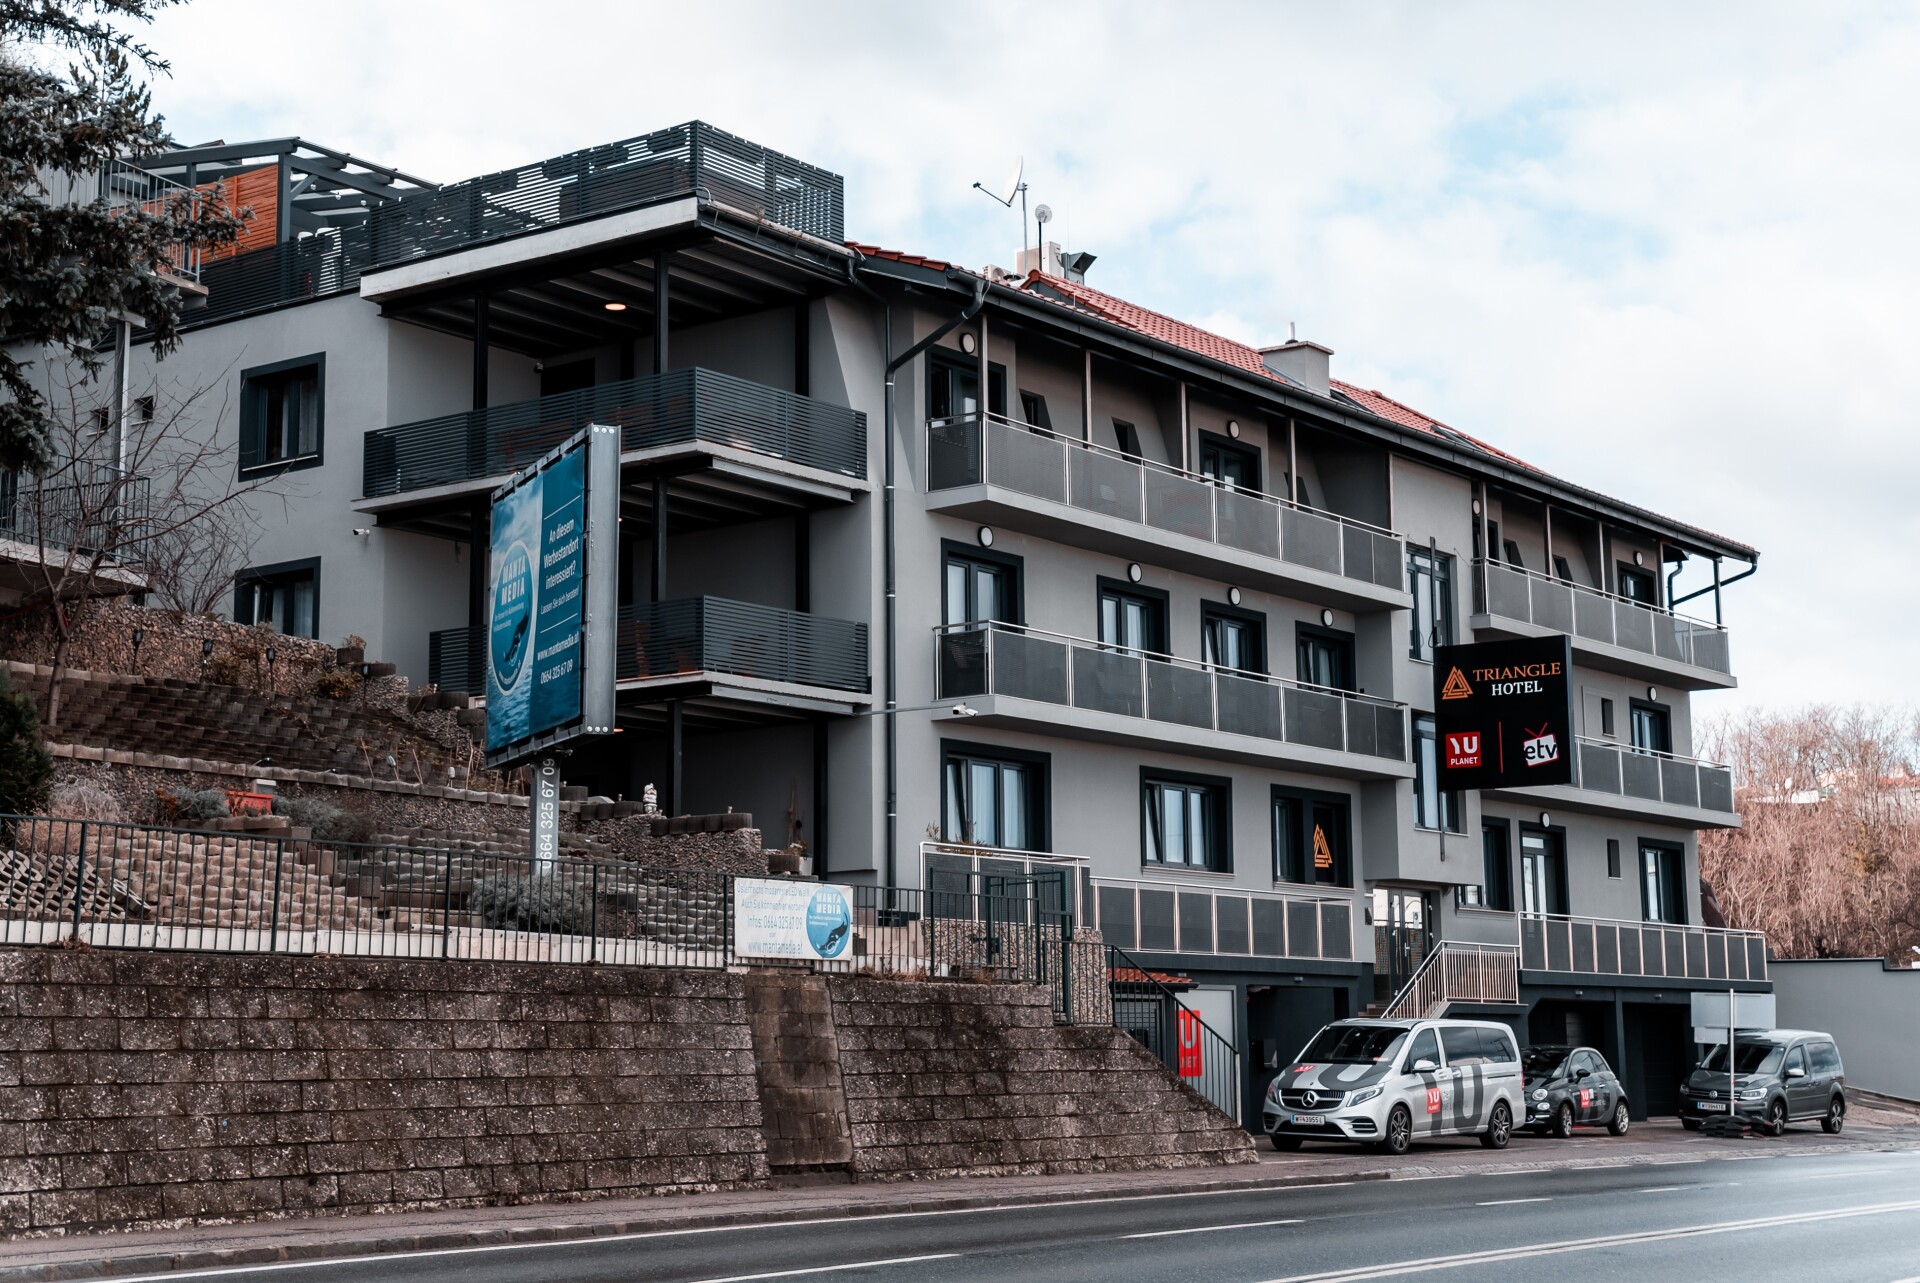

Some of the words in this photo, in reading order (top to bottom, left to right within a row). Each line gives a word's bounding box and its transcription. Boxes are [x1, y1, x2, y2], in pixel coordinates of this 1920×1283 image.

[549, 529, 556, 544] An
[556, 518, 575, 539] diesem
[543, 536, 579, 569] Werbestandort
[502, 555, 526, 585] MANTA
[545, 560, 576, 590] interessiert?
[501, 577, 525, 606] MEDIA
[540, 600, 553, 615] Lassen
[537, 630, 580, 661] www.mantamedia.at
[552, 664, 561, 680] 325
[560, 661, 567, 676] 67
[566, 658, 574, 673] 09
[1472, 662, 1561, 682] TRIANGLE
[1491, 680, 1543, 697] HOTEL
[1450, 736, 1478, 755] YU
[1524, 739, 1557, 760] etv
[542, 758, 555, 776] 09
[1450, 756, 1478, 766] PLANET
[541, 780, 555, 798] 67
[540, 802, 554, 829] 325
[816, 892, 841, 903] MANTA
[816, 903, 841, 915] MEDIA
[763, 914, 778, 929] 0664
[778, 915, 789, 930] 325
[795, 916, 803, 931] 09
[1428, 1090, 1440, 1104] YU
